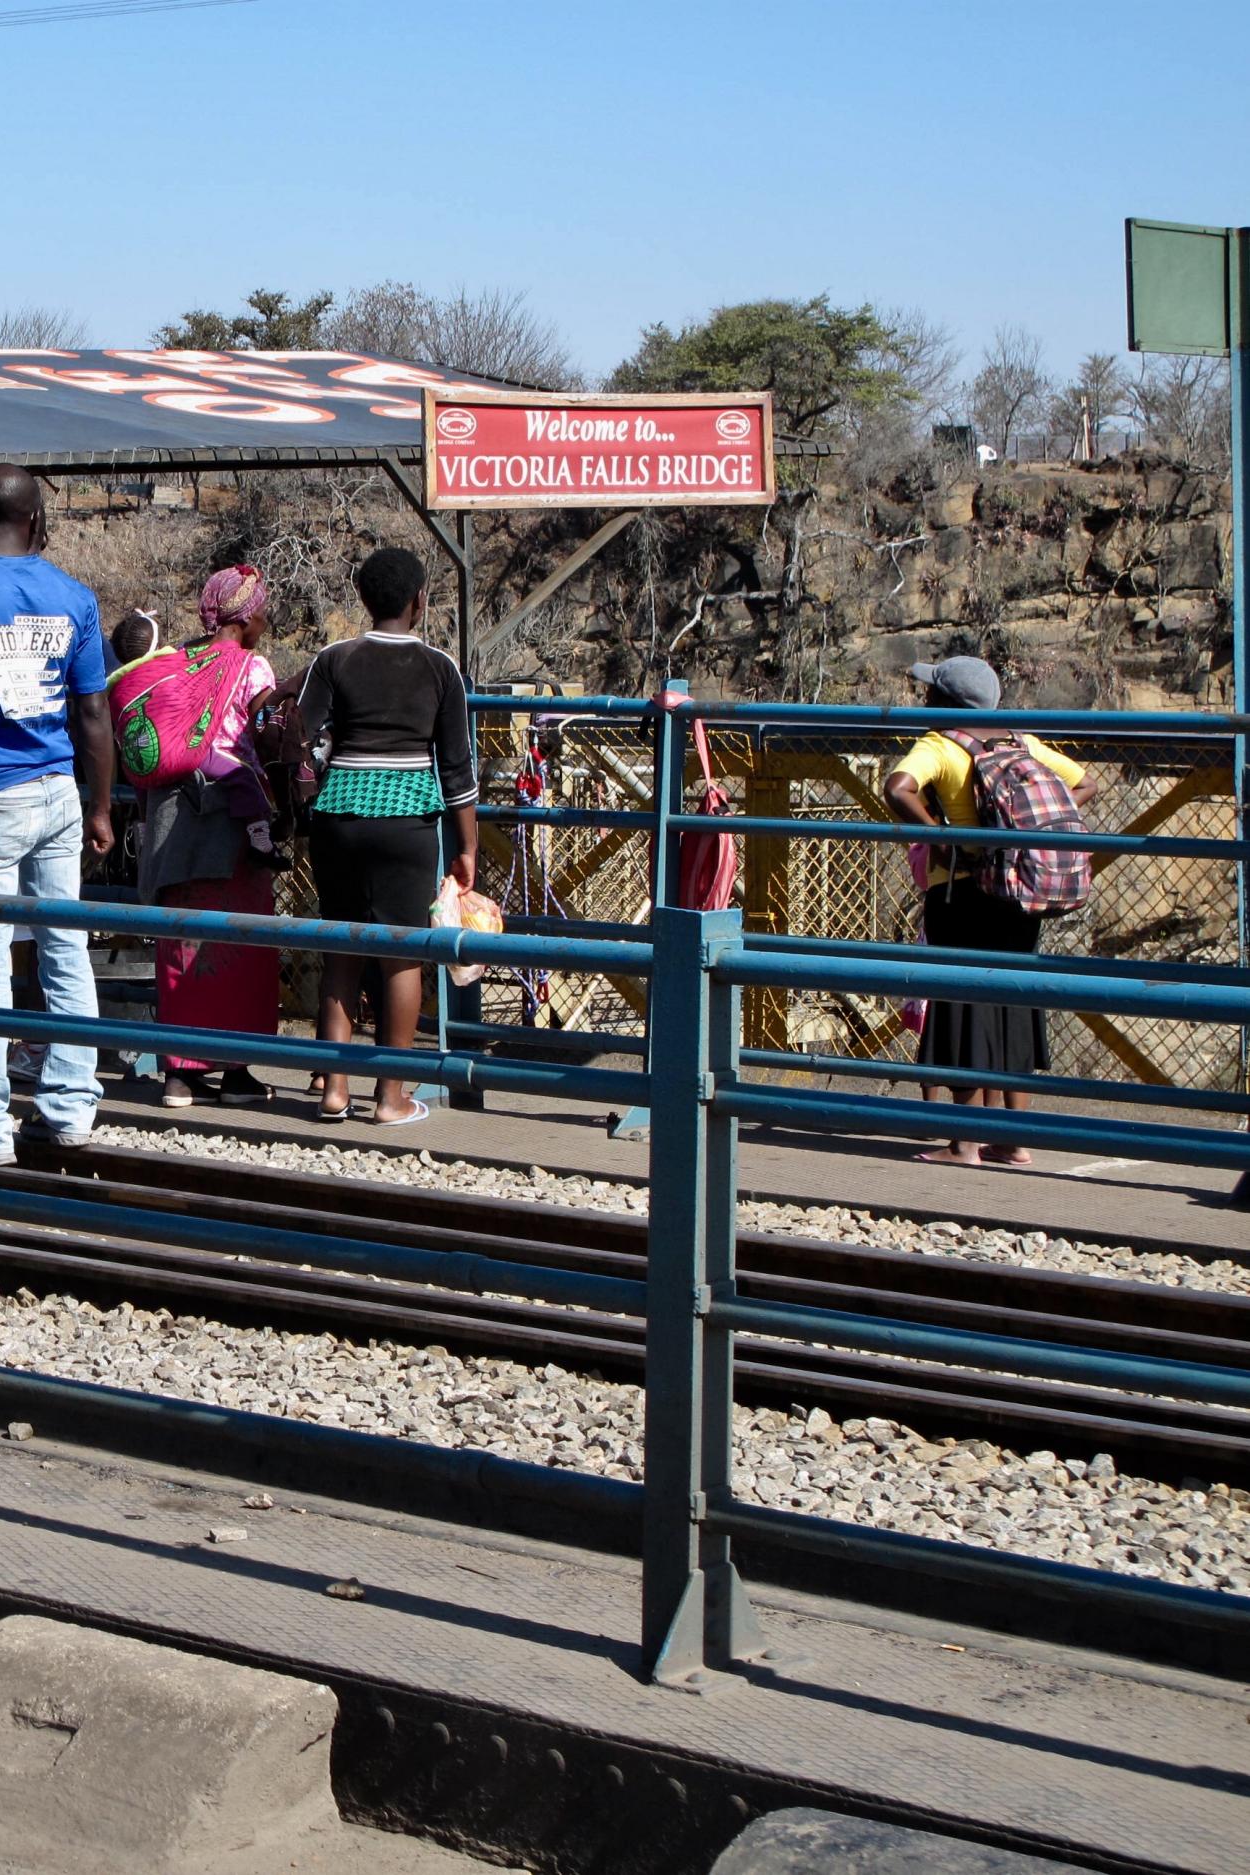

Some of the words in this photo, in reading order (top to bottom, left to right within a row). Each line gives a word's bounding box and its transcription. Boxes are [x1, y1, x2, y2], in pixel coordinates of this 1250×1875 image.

[525, 411, 628, 443] Welcome
[634, 415, 675, 443] to...
[438, 455, 574, 487] VICTORIA
[579, 455, 650, 486] FALLS
[656, 454, 753, 486] BRIDGE
[17, 617, 56, 625] ROUND
